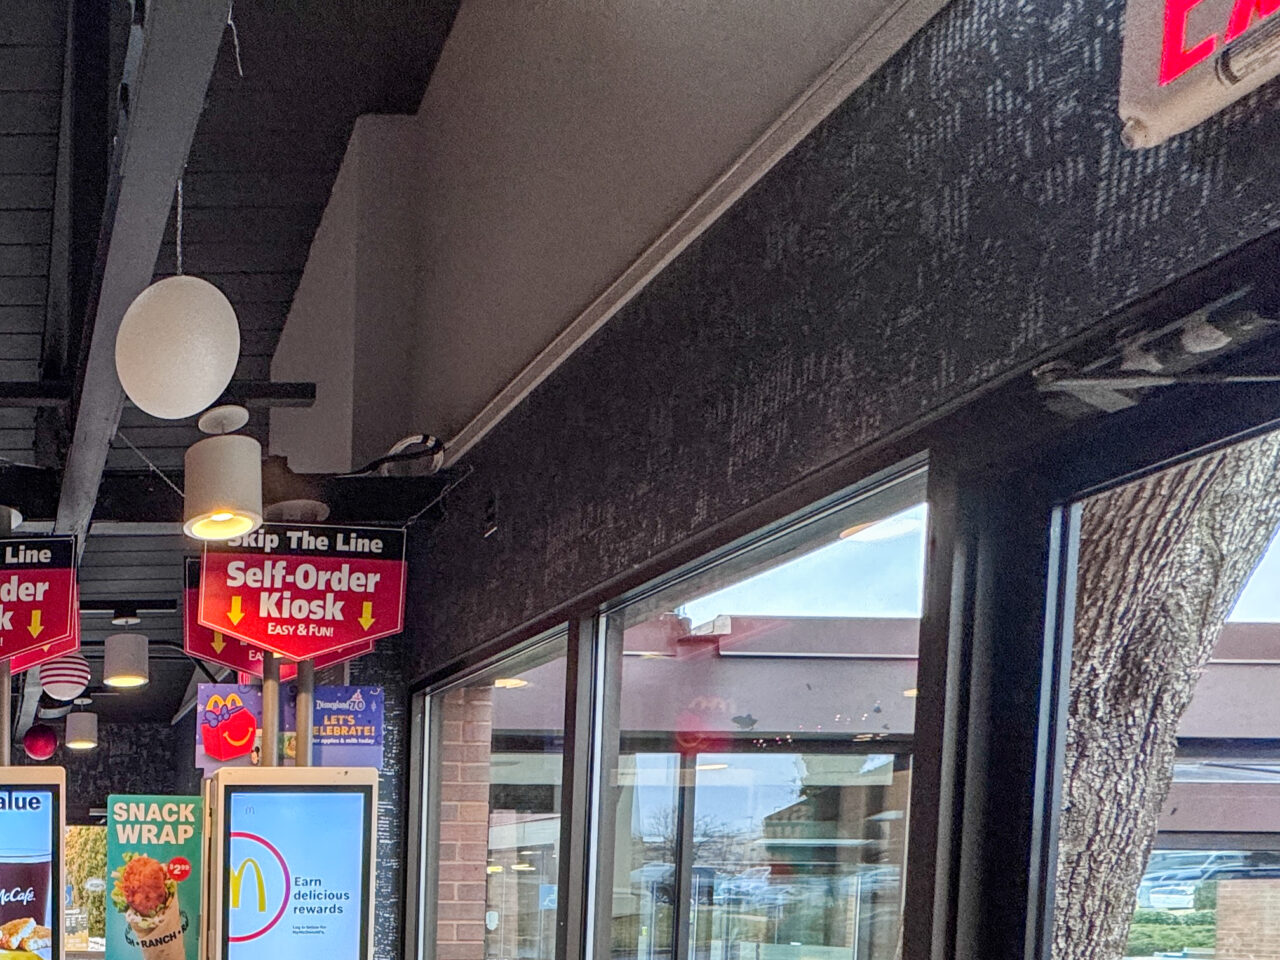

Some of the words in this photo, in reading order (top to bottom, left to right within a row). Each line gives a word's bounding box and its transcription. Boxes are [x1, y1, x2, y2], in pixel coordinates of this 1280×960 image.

[286, 530, 328, 551] The
[336, 533, 384, 553] Line
[5, 545, 52, 564] Line
[226, 560, 381, 593] Self-Order
[259, 592, 345, 621] Kiosk
[267, 623, 295, 636] EASY
[297, 624, 307, 636] &
[309, 624, 334, 637] FUN!
[324, 715, 355, 725] LET'S
[312, 726, 375, 736] ELEBRATE!
[113, 802, 195, 822] SNACK
[116, 824, 195, 844] WRAP
[294, 877, 322, 886] Earn
[293, 890, 350, 900] delicious
[293, 904, 343, 914] rewards
[141, 931, 177, 948] RANCH
